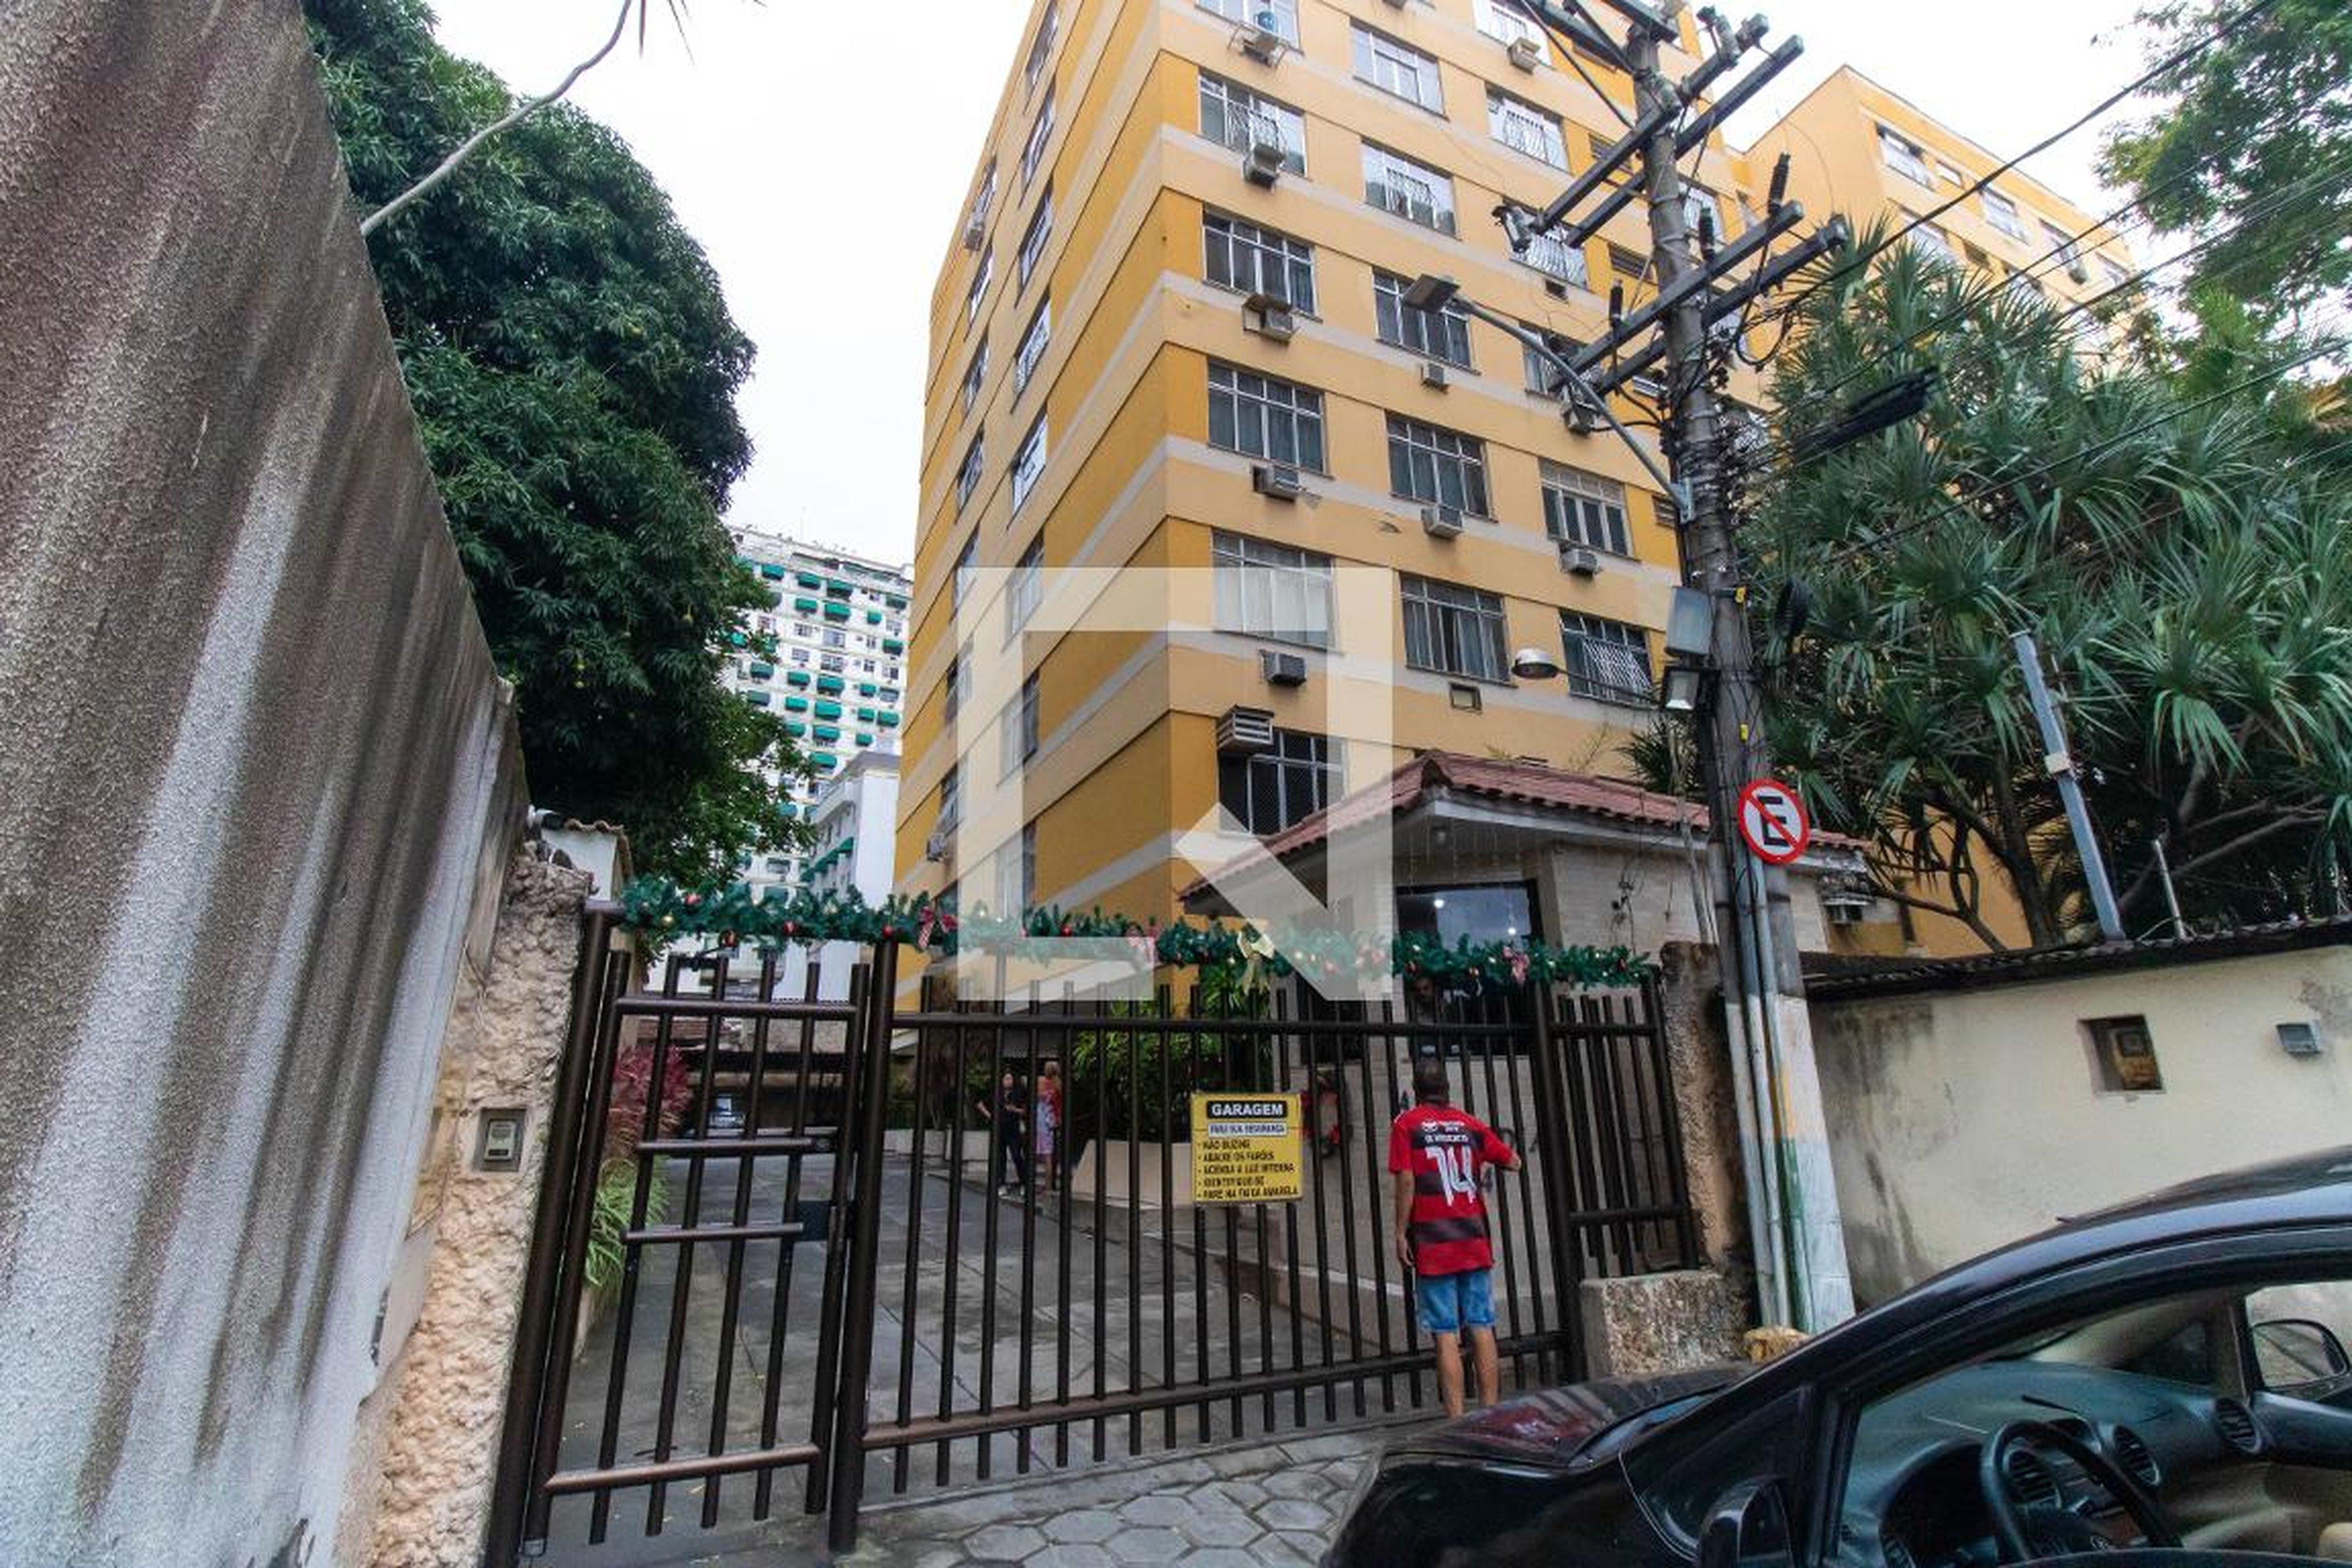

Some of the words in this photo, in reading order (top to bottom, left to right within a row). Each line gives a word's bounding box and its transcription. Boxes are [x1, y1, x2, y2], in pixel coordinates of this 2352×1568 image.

[1758, 796, 1791, 847] E
[1211, 1104, 1283, 1116] GARAGEM
[1424, 1145, 1476, 1207] 14
